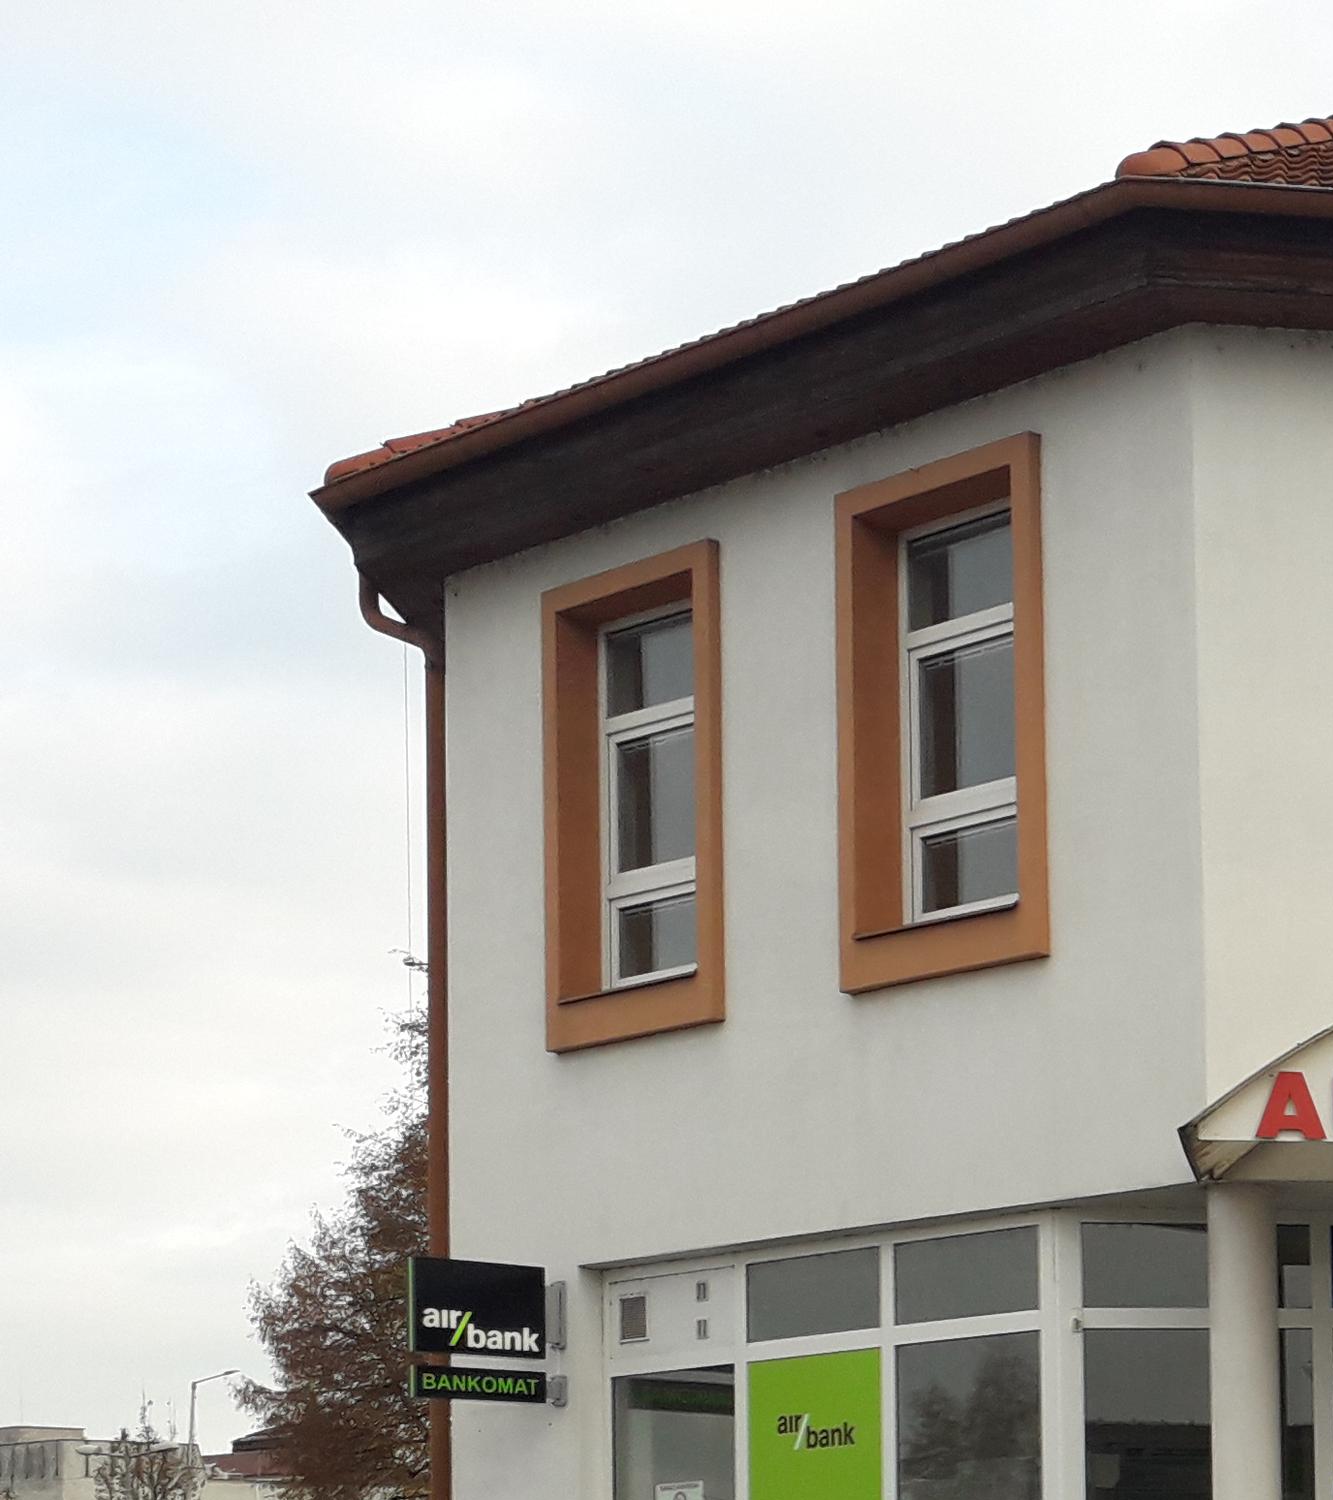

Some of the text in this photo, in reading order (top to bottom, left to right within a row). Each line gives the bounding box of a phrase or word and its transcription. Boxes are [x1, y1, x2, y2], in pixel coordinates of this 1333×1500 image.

[421, 1307, 540, 1353] air bank
[421, 1373, 539, 1396] BANKOMAT
[776, 1413, 856, 1450] air bank
